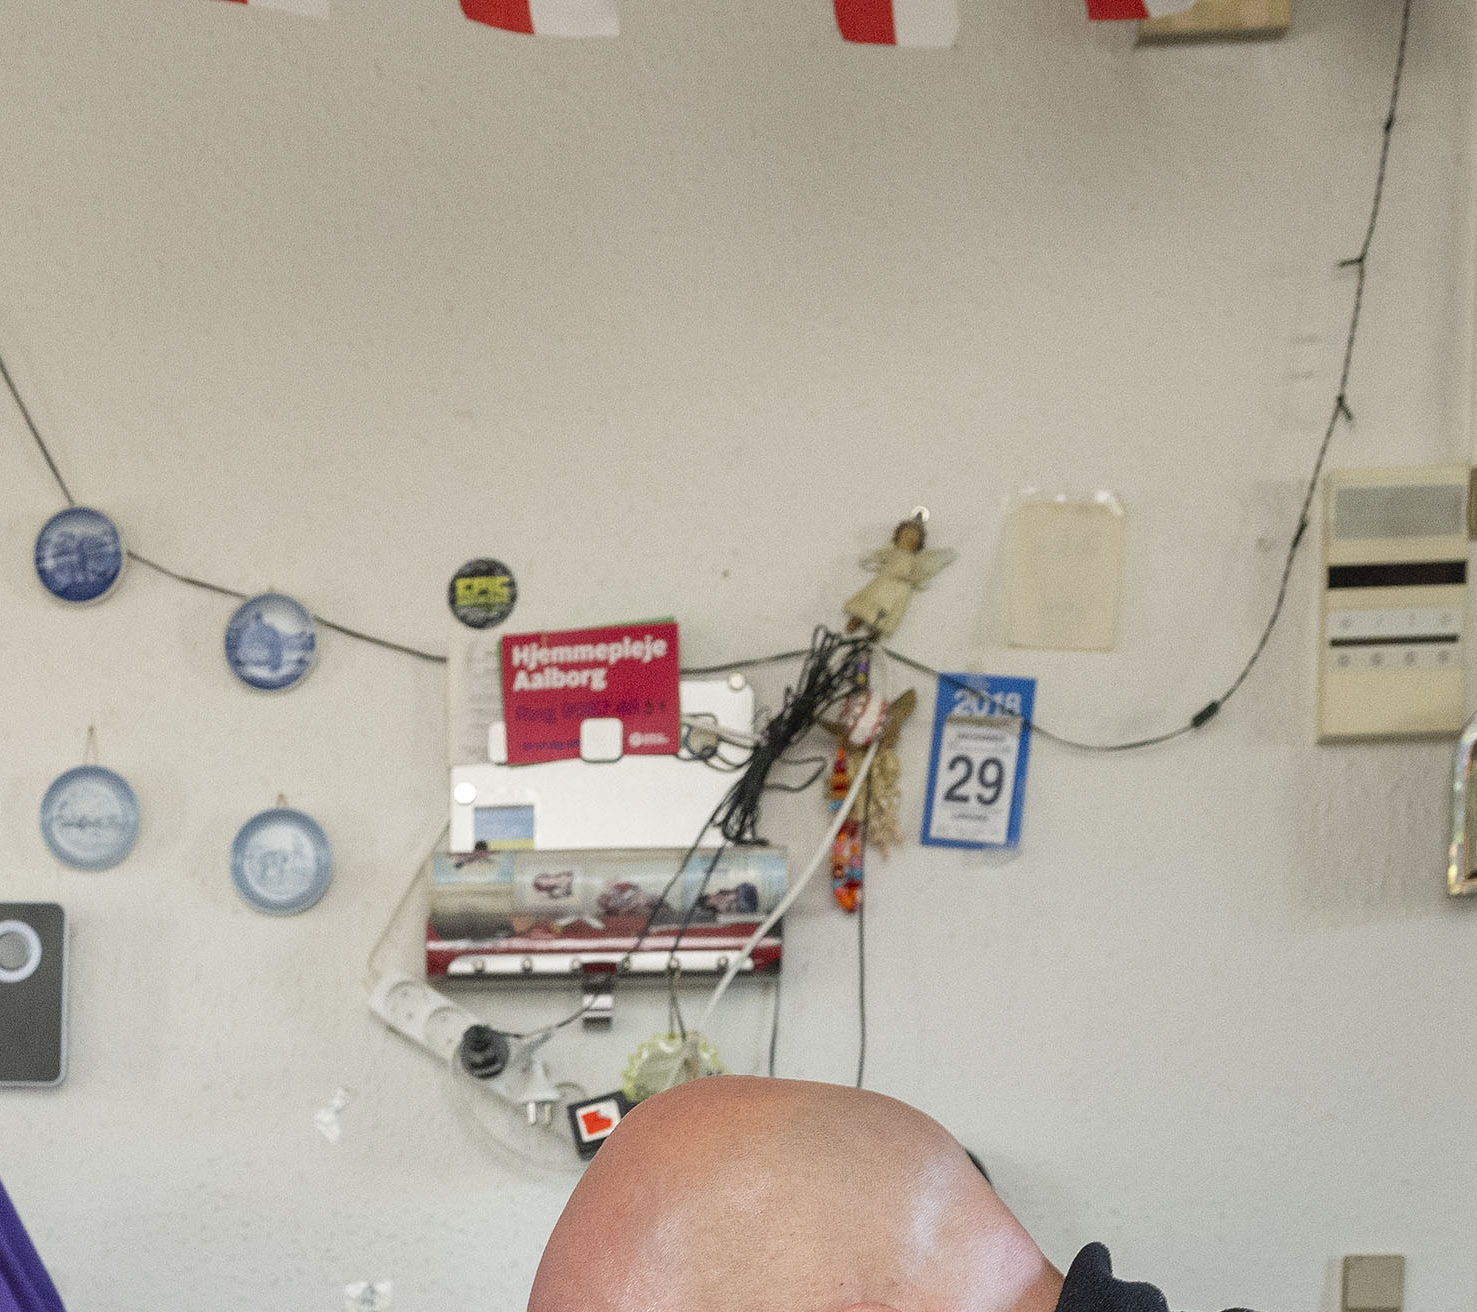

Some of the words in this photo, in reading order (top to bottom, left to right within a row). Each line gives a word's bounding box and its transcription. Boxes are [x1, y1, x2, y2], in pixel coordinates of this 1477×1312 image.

[512, 635, 668, 669] Hjemmepleje
[513, 667, 607, 692] Aalborg
[944, 754, 1004, 806] 29
